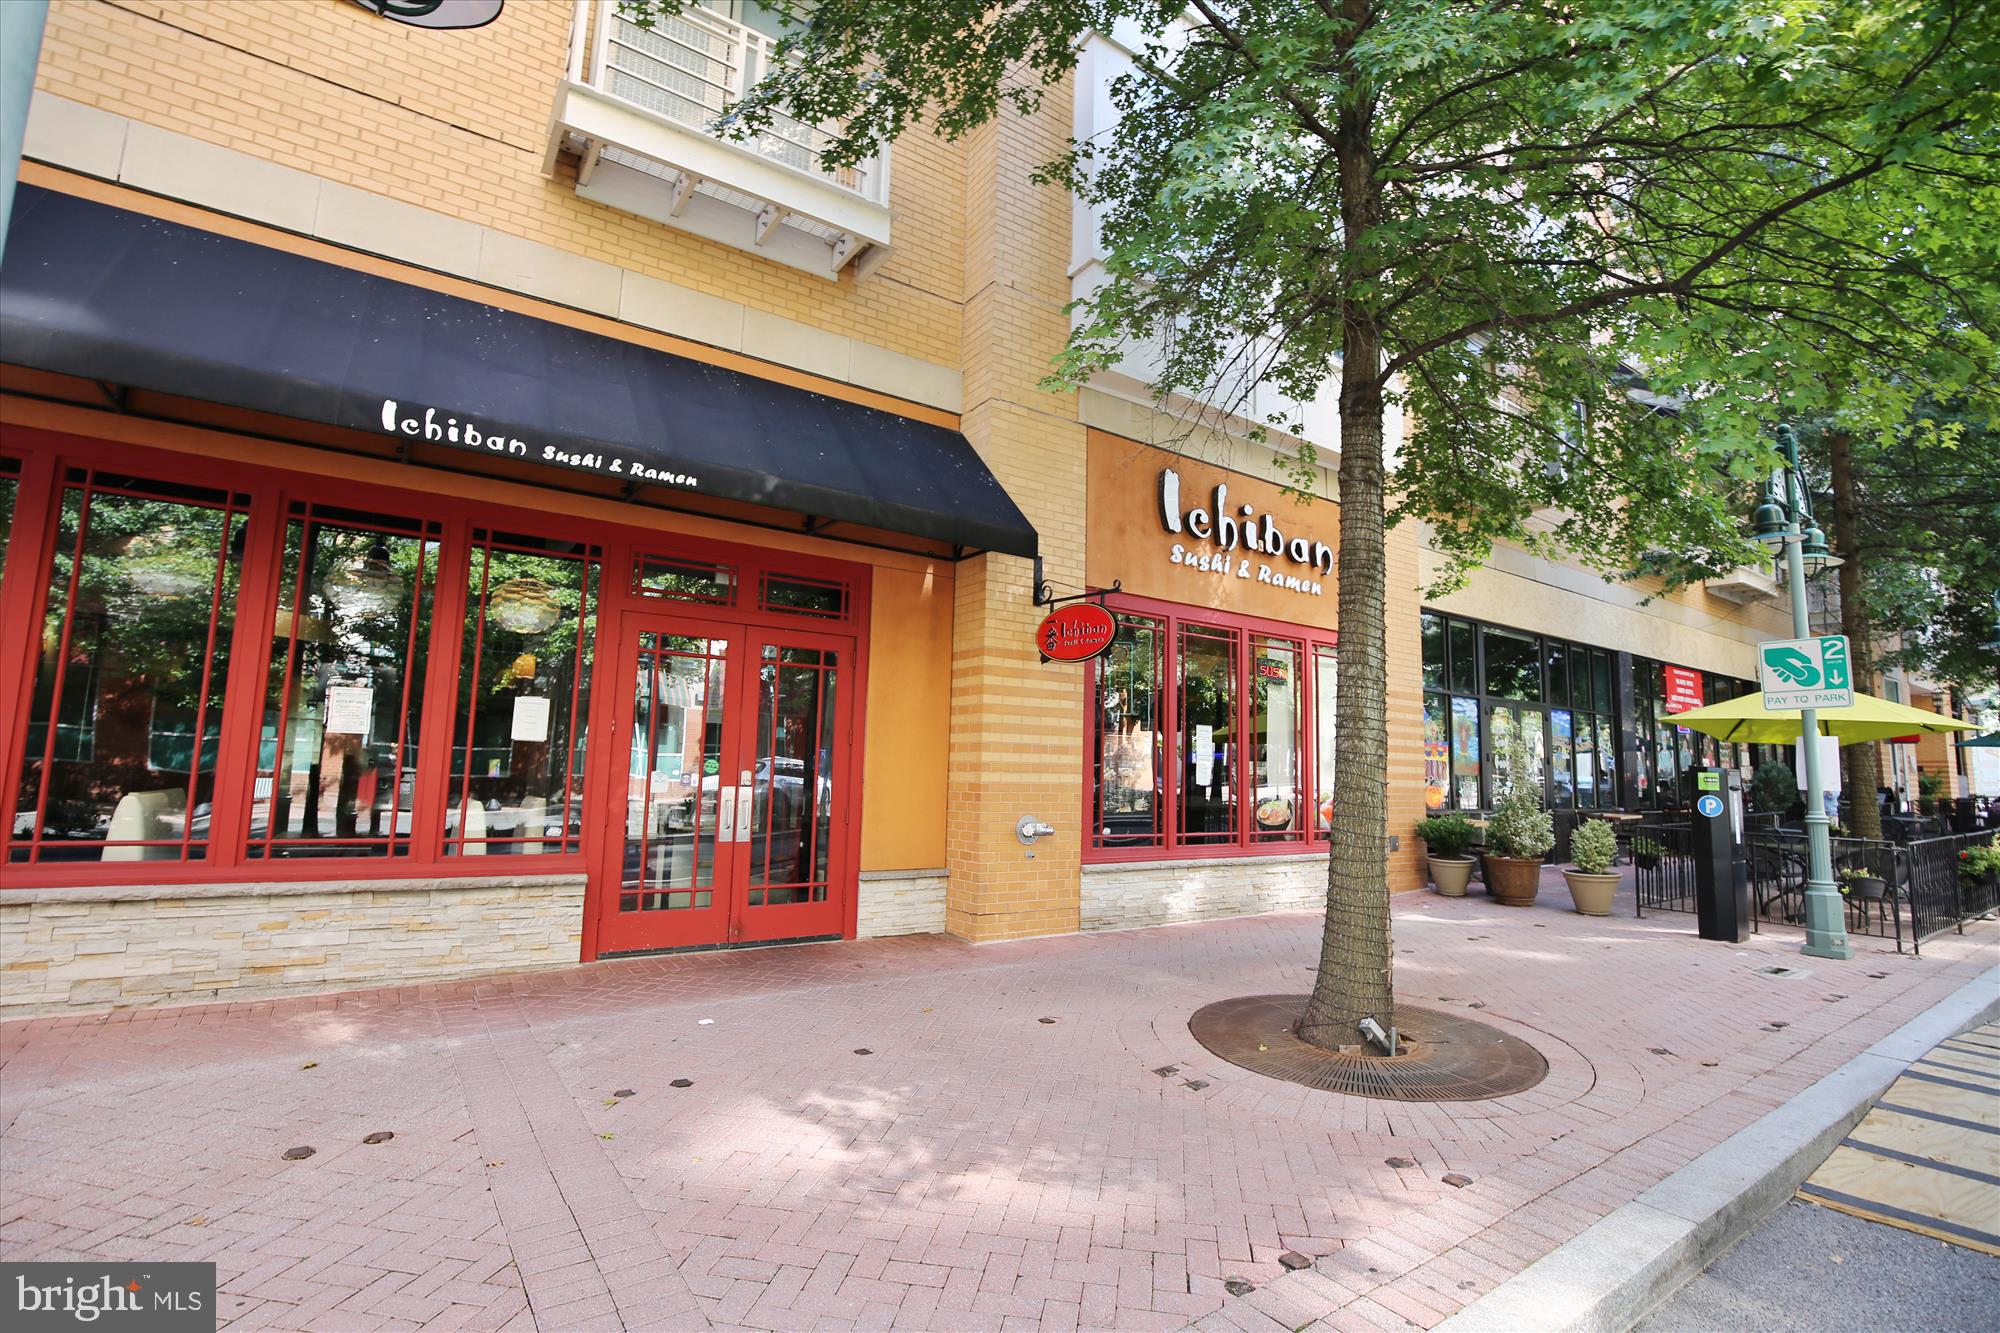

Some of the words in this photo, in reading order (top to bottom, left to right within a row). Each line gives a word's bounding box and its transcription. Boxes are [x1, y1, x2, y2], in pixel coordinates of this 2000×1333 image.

[381, 399, 528, 457] Ichiban
[542, 445, 602, 469] Sushi
[608, 458, 623, 473] &
[629, 462, 698, 487] Ramen
[1159, 467, 1335, 577] Ichiban
[1168, 544, 1232, 575] Sushi
[1237, 559, 1251, 579] &
[1257, 564, 1323, 597] Ramen
[1822, 640, 1845, 660] 2
[1767, 696, 1788, 705] PAY
[1793, 695, 1809, 704] TO
[1814, 693, 1846, 703] PARK
[1705, 799, 1717, 814] P
